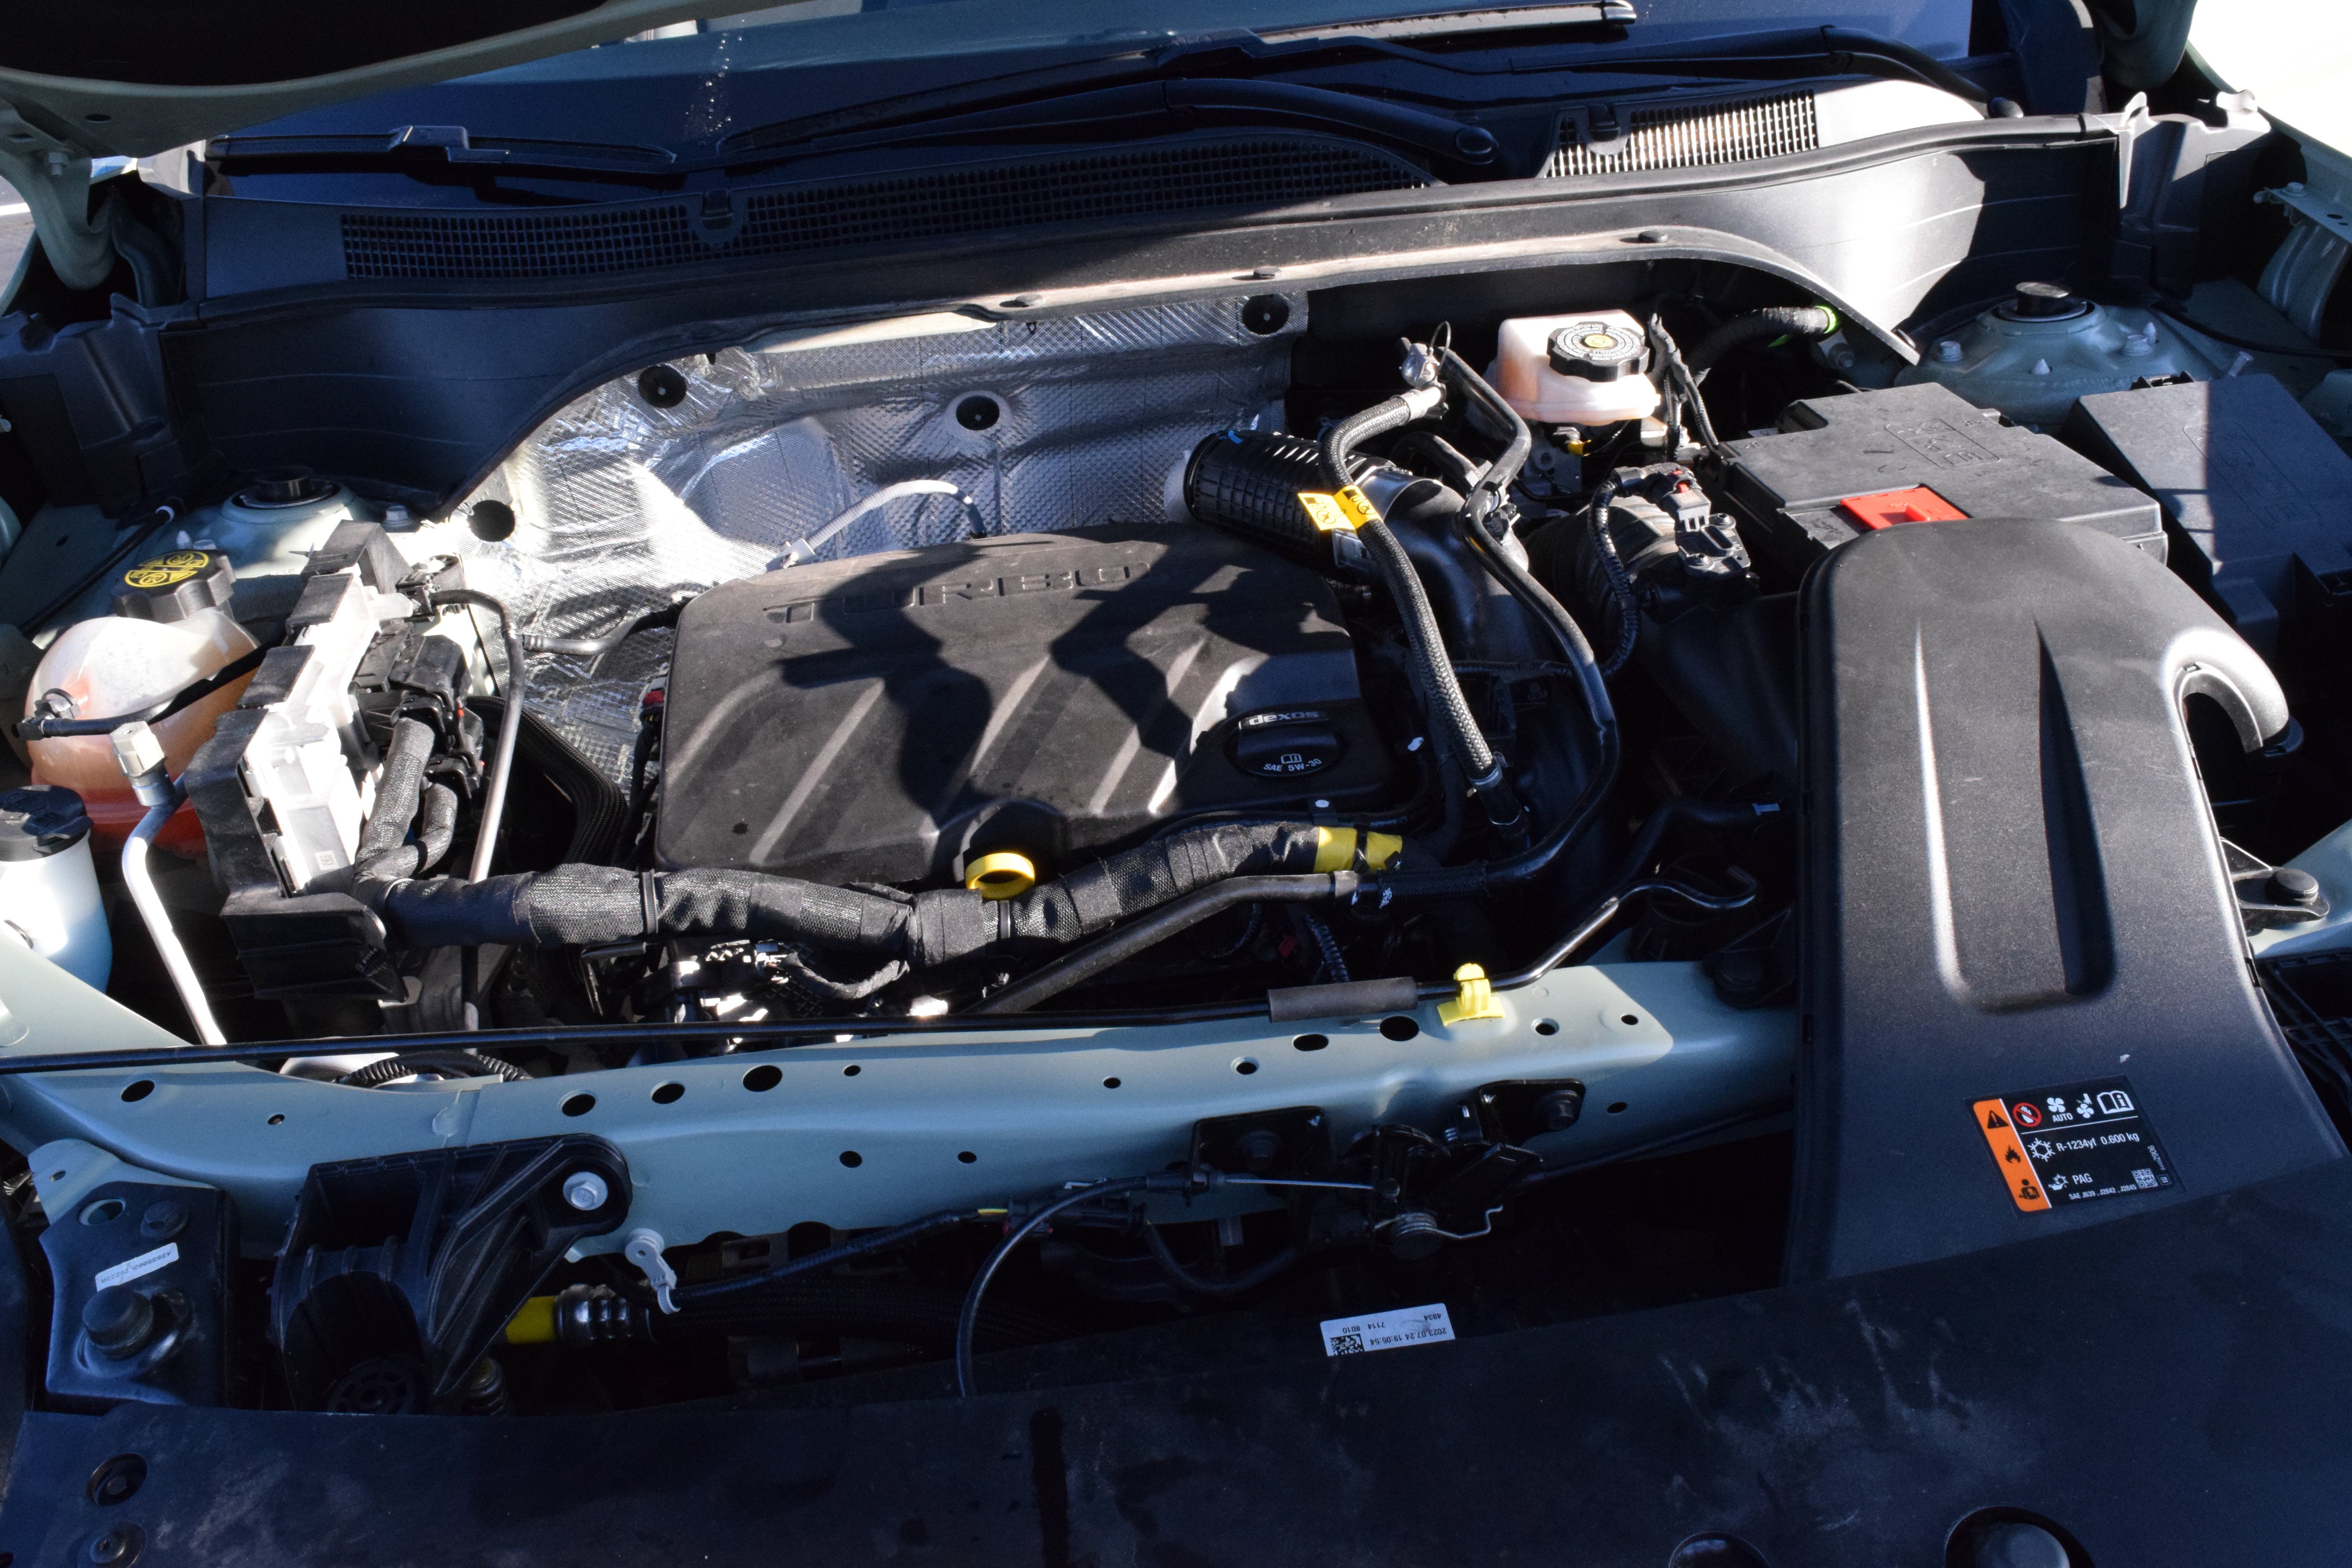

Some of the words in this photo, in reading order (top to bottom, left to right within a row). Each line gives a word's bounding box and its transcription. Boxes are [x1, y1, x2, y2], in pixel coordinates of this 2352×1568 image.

[762, 561, 1151, 624] TURBO
[1249, 711, 1319, 725] dexos
[1263, 763, 1283, 771] SAE
[1288, 758, 1322, 771] 5W-30
[2052, 1113, 2073, 1123] AUTO
[2056, 1138, 2097, 1152] R-1234yf
[2100, 1134, 2125, 1145] 0.600
[2126, 1132, 2140, 1143] kg
[2072, 1173, 2093, 1185] PAG
[1424, 1313, 1441, 1321] 4934
[1370, 1334, 1402, 1345] 19:05:54
[1405, 1327, 1447, 1341] 2023.07.24
